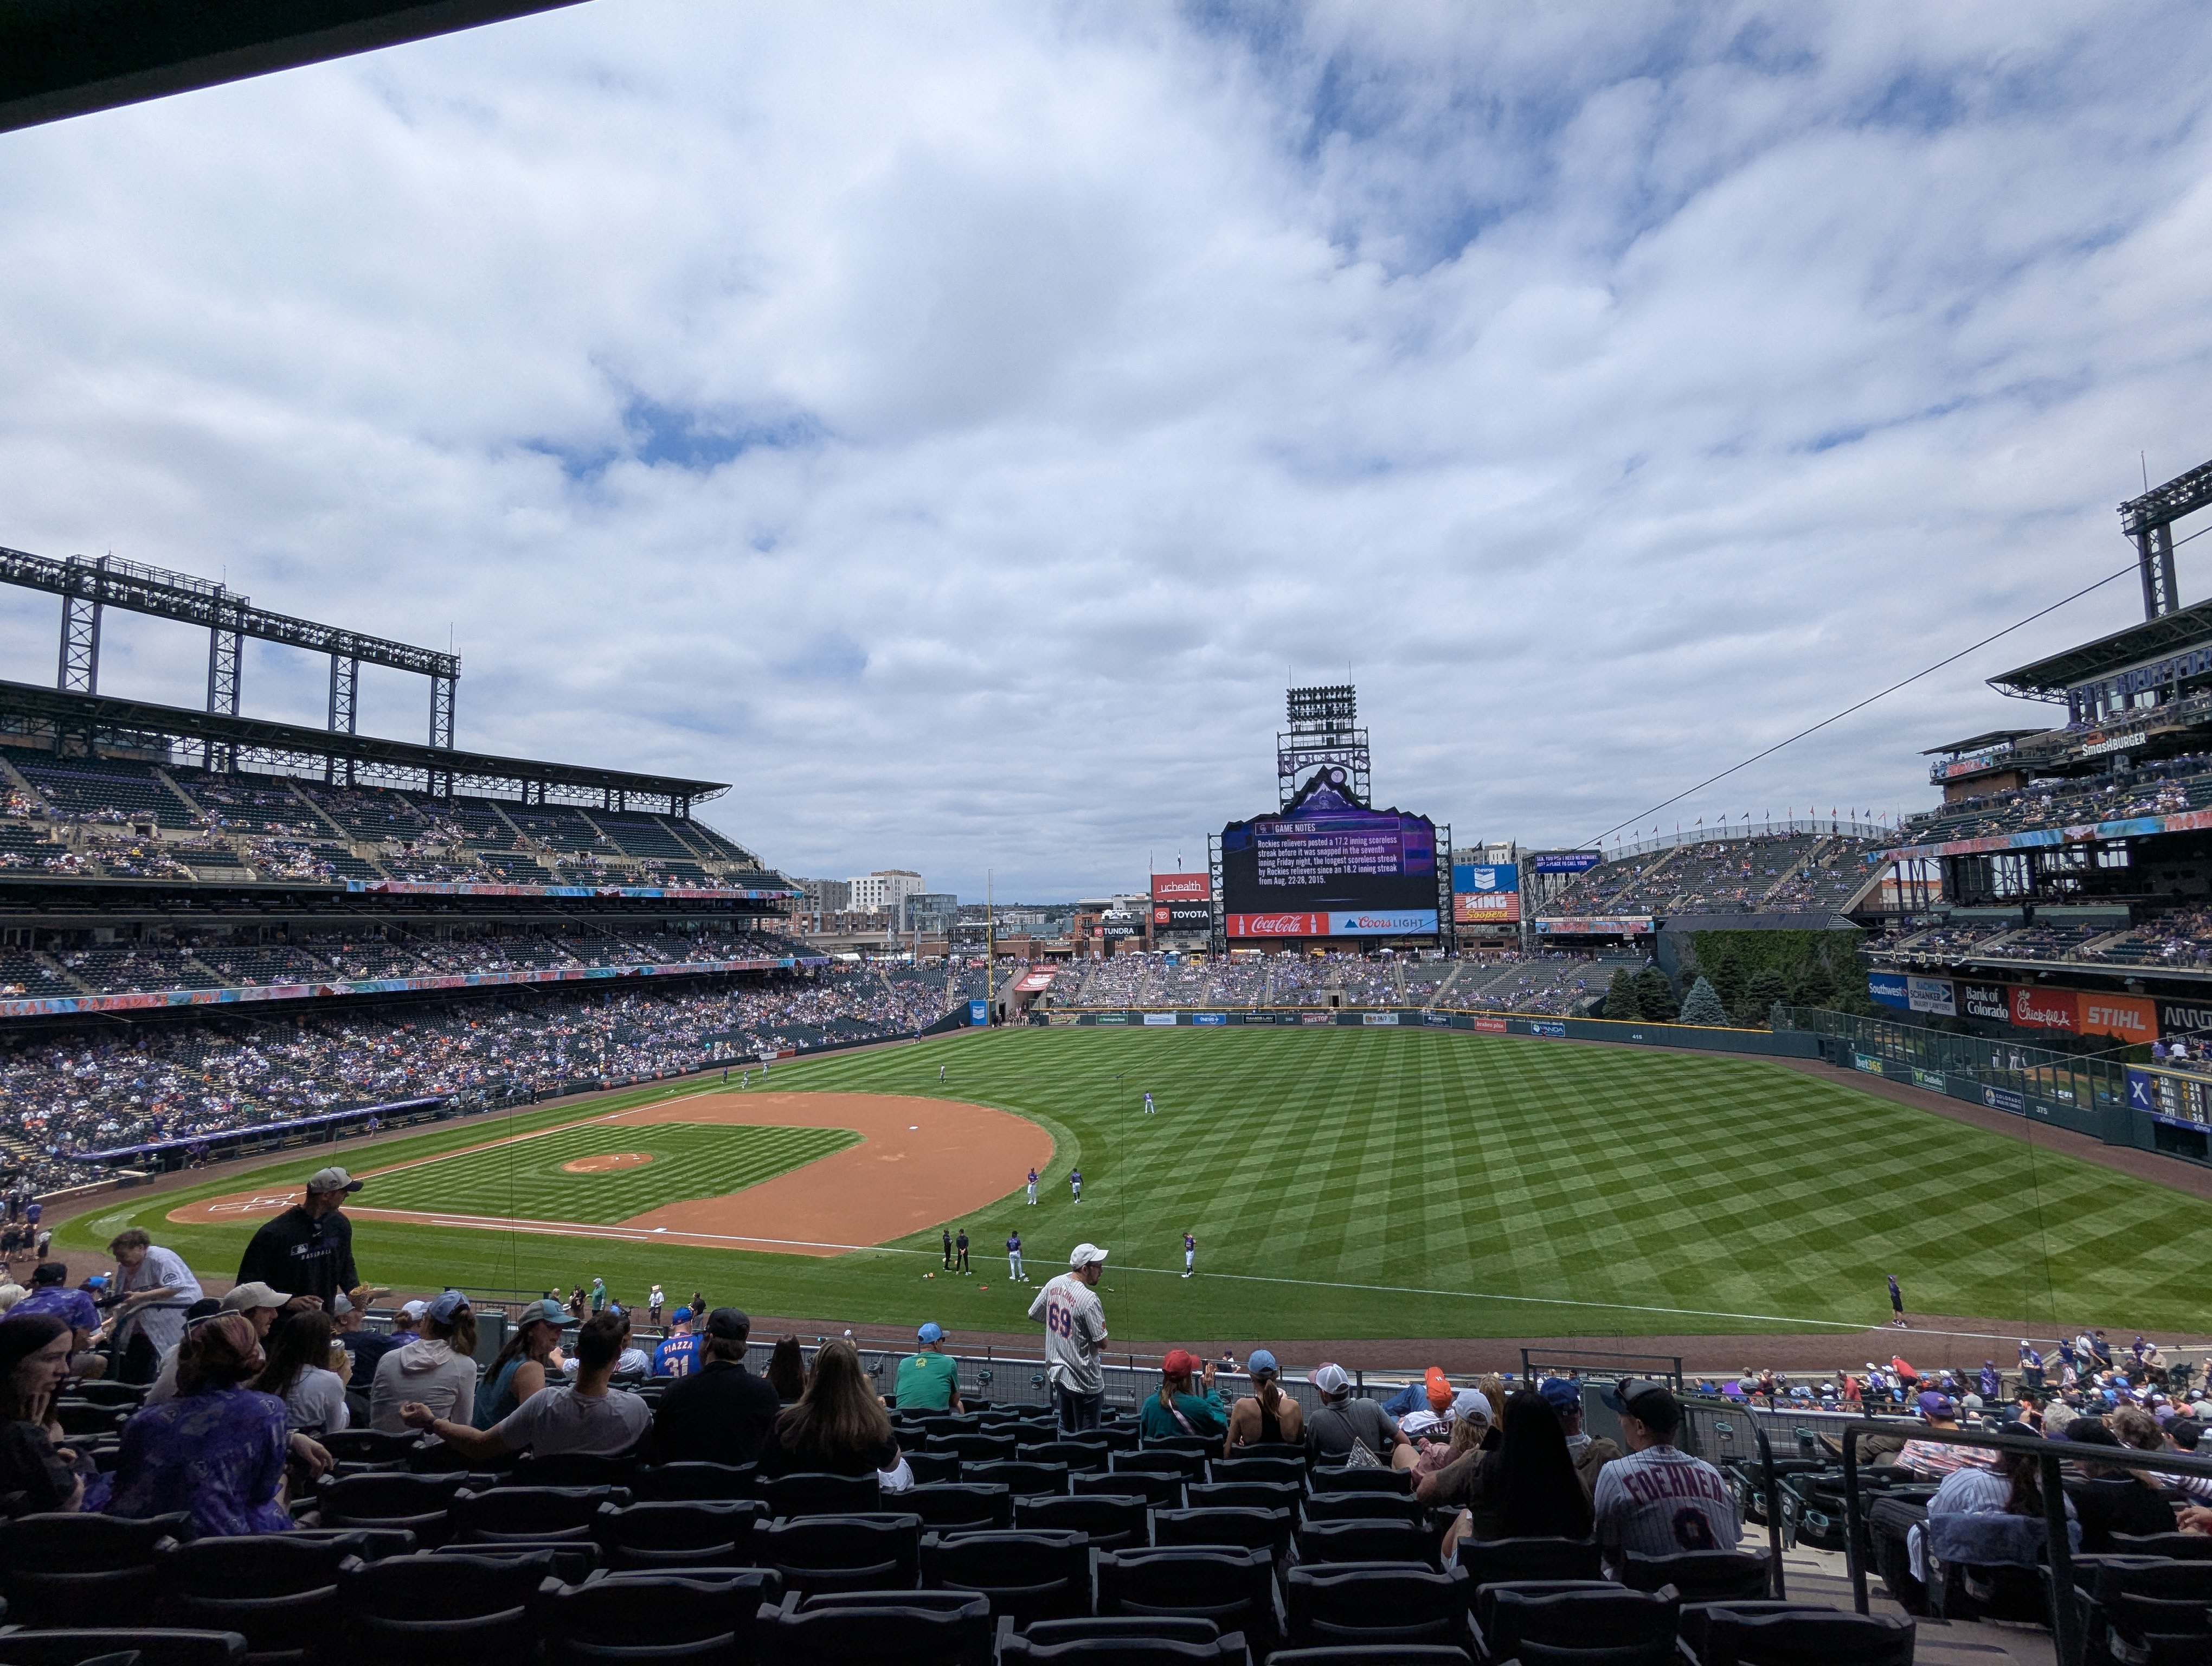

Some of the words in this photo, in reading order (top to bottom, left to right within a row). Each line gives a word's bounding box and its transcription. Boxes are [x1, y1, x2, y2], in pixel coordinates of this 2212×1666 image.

[1277, 749, 1371, 773] ROCKIES
[1275, 824, 1293, 833] GAME
[1295, 824, 1316, 832] NOTES
[1258, 840, 1280, 848] Rockies
[1281, 839, 1307, 848] relievers
[1308, 838, 1328, 847] posted
[1335, 837, 1348, 845] 17.2
[1349, 837, 1367, 847] inning
[1368, 836, 1397, 844] scoreless
[1258, 849, 1277, 857] streak
[1278, 849, 1297, 857] before
[1317, 848, 1341, 857] snapped
[1361, 845, 1384, 854] seventh
[1258, 858, 1275, 868] inning
[1277, 858, 1295, 868] Friday
[1296, 857, 1313, 867] night,
[1314, 857, 1323, 865] the
[1324, 856, 1347, 866] longest
[1348, 855, 1376, 863] scoreless
[1378, 854, 1398, 863] streak
[1259, 868, 1266, 877] by
[1266, 867, 1289, 875] Rockies
[1290, 866, 1316, 874] relievers
[1343, 865, 1356, 873] 18.2
[1358, 864, 1376, 874] inning
[1378, 864, 1398, 872] streak
[1161, 880, 1201, 892] uchealth
[1259, 877, 1272, 885] from
[1274, 877, 1287, 886] Aug.
[1288, 876, 1307, 885] 22-28,
[1309, 876, 1326, 884] 2015.
[1465, 895, 1507, 908] KING
[1172, 911, 1208, 919] TOYOTA
[1467, 908, 1508, 921] Soopers
[1251, 915, 1302, 933] Coca-Cola
[1359, 916, 1391, 928] Coors
[1393, 919, 1423, 927] LIGHT
[1869, 983, 1902, 997] Southwest
[1910, 990, 1941, 1002] SCHANKER
[1966, 986, 1988, 1001] Bank
[1989, 988, 1998, 1002] of
[78, 994, 168, 1010] PARADISE
[192, 991, 222, 1003] DAY
[1967, 1002, 2009, 1019] Colorado
[2088, 1006, 2146, 1030] STIHL
[2166, 1032, 2186, 1043] Five
[1856, 1056, 1882, 1072] bet365
[2189, 1082, 2200, 1092] 38
[1996, 1093, 2022, 1104] COLORADO
[2161, 1086, 2174, 1097] MIL
[2189, 1092, 2201, 1102] 51
[2036, 1106, 2048, 1115] 375
[2191, 1103, 2202, 1112] 61
[2192, 1113, 2204, 1123] 30
[1048, 1302, 1072, 1339] 69
[664, 1341, 693, 1355] PIAZZA
[664, 1355, 689, 1376] 31
[1622, 1464, 1724, 1506] FOEHNER
